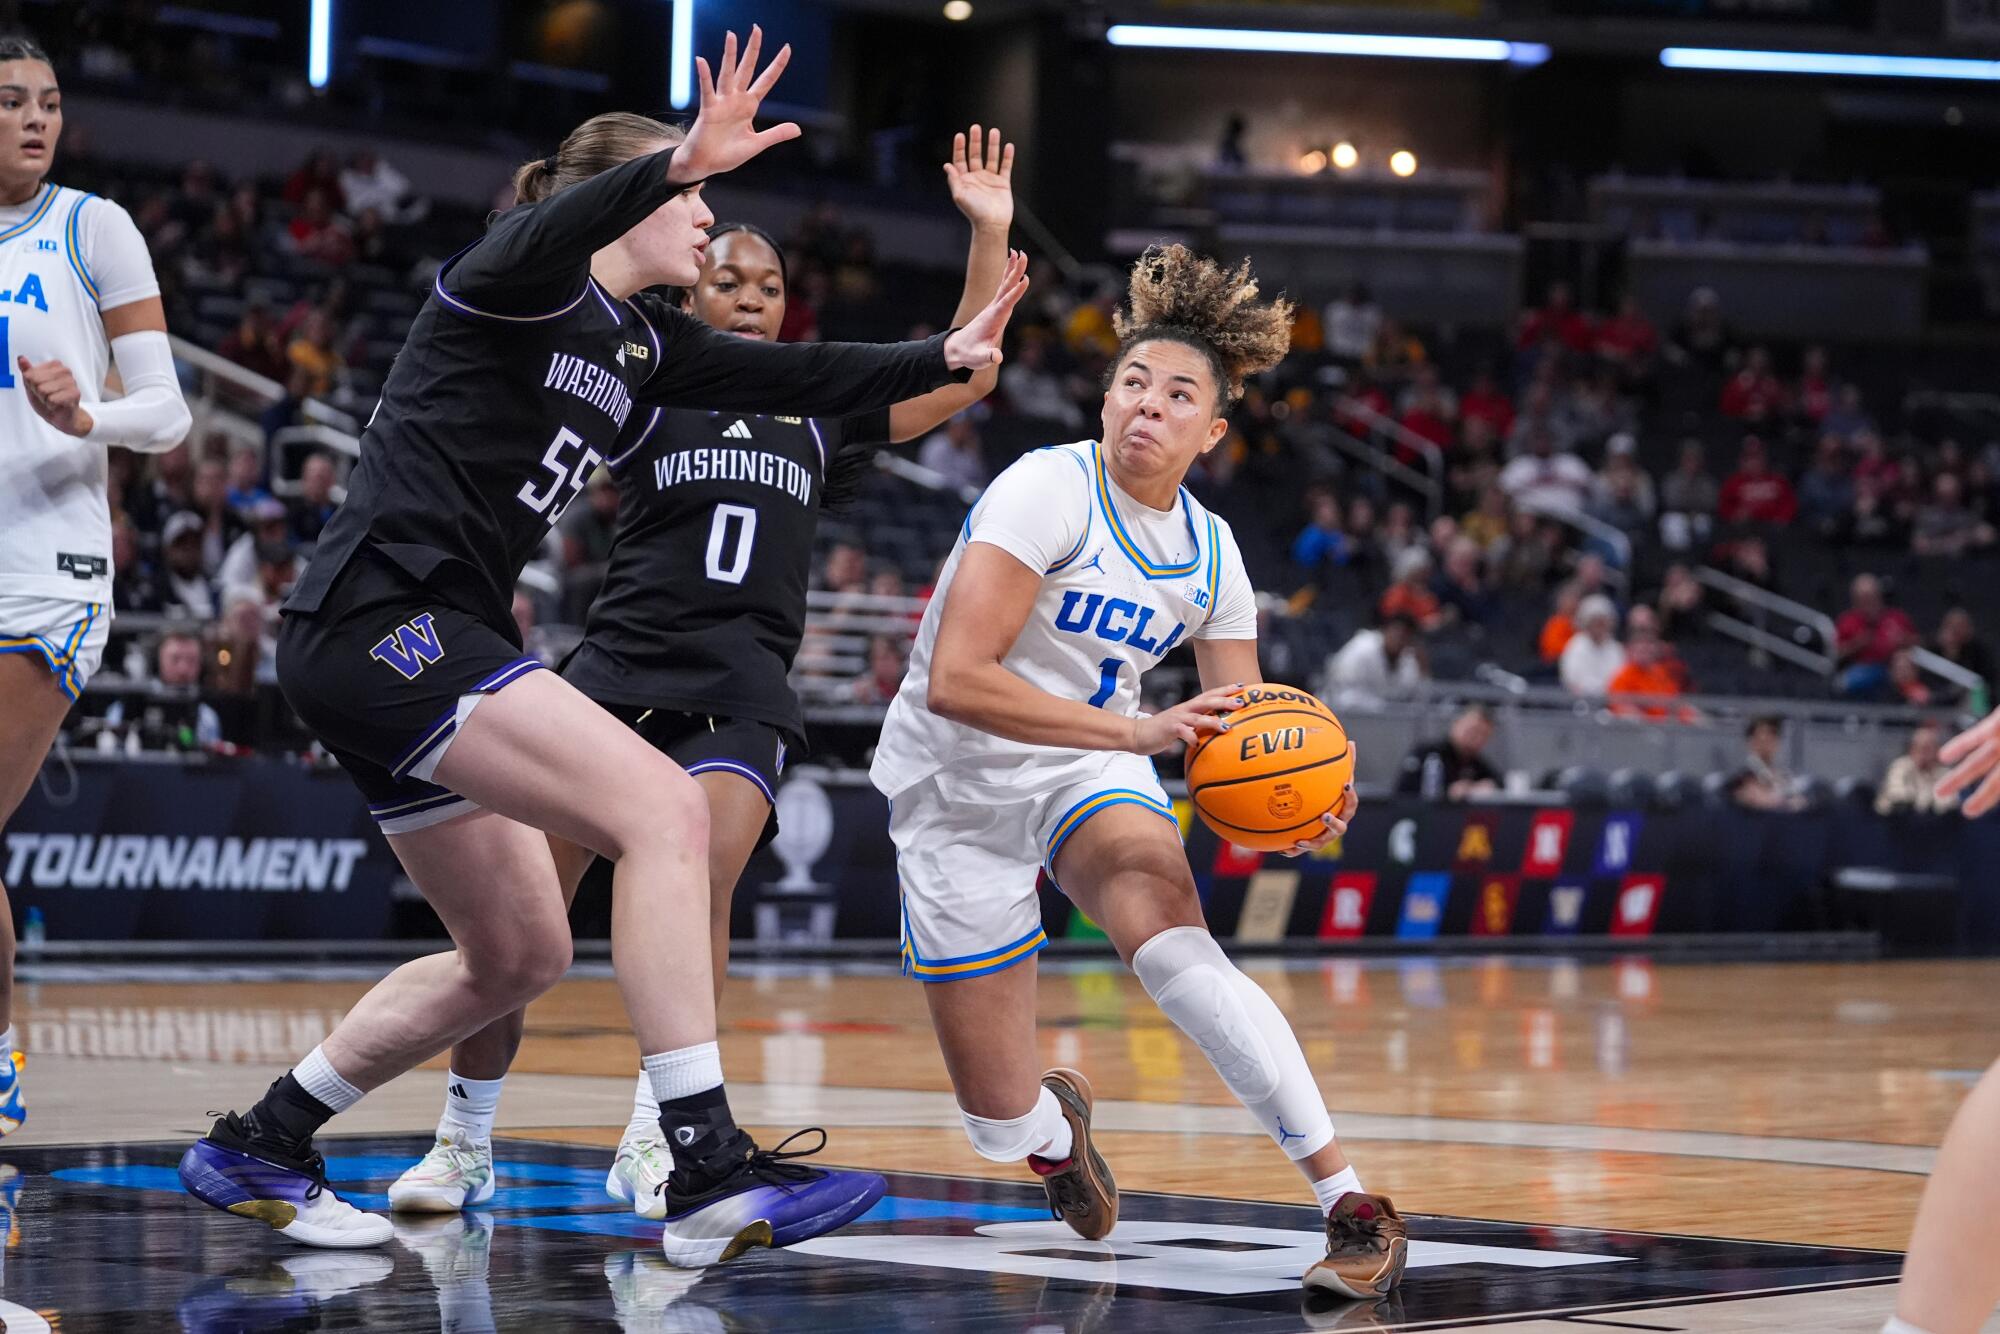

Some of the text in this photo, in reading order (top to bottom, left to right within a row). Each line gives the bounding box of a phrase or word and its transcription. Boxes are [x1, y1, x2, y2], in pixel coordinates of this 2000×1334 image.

[517, 426, 603, 526] 55
[653, 448, 812, 507] WASHINGTON
[705, 503, 756, 584] 0
[368, 611, 446, 681] W
[1087, 657, 1126, 709] 1
[4, 834, 367, 891] TOURNAMENT
